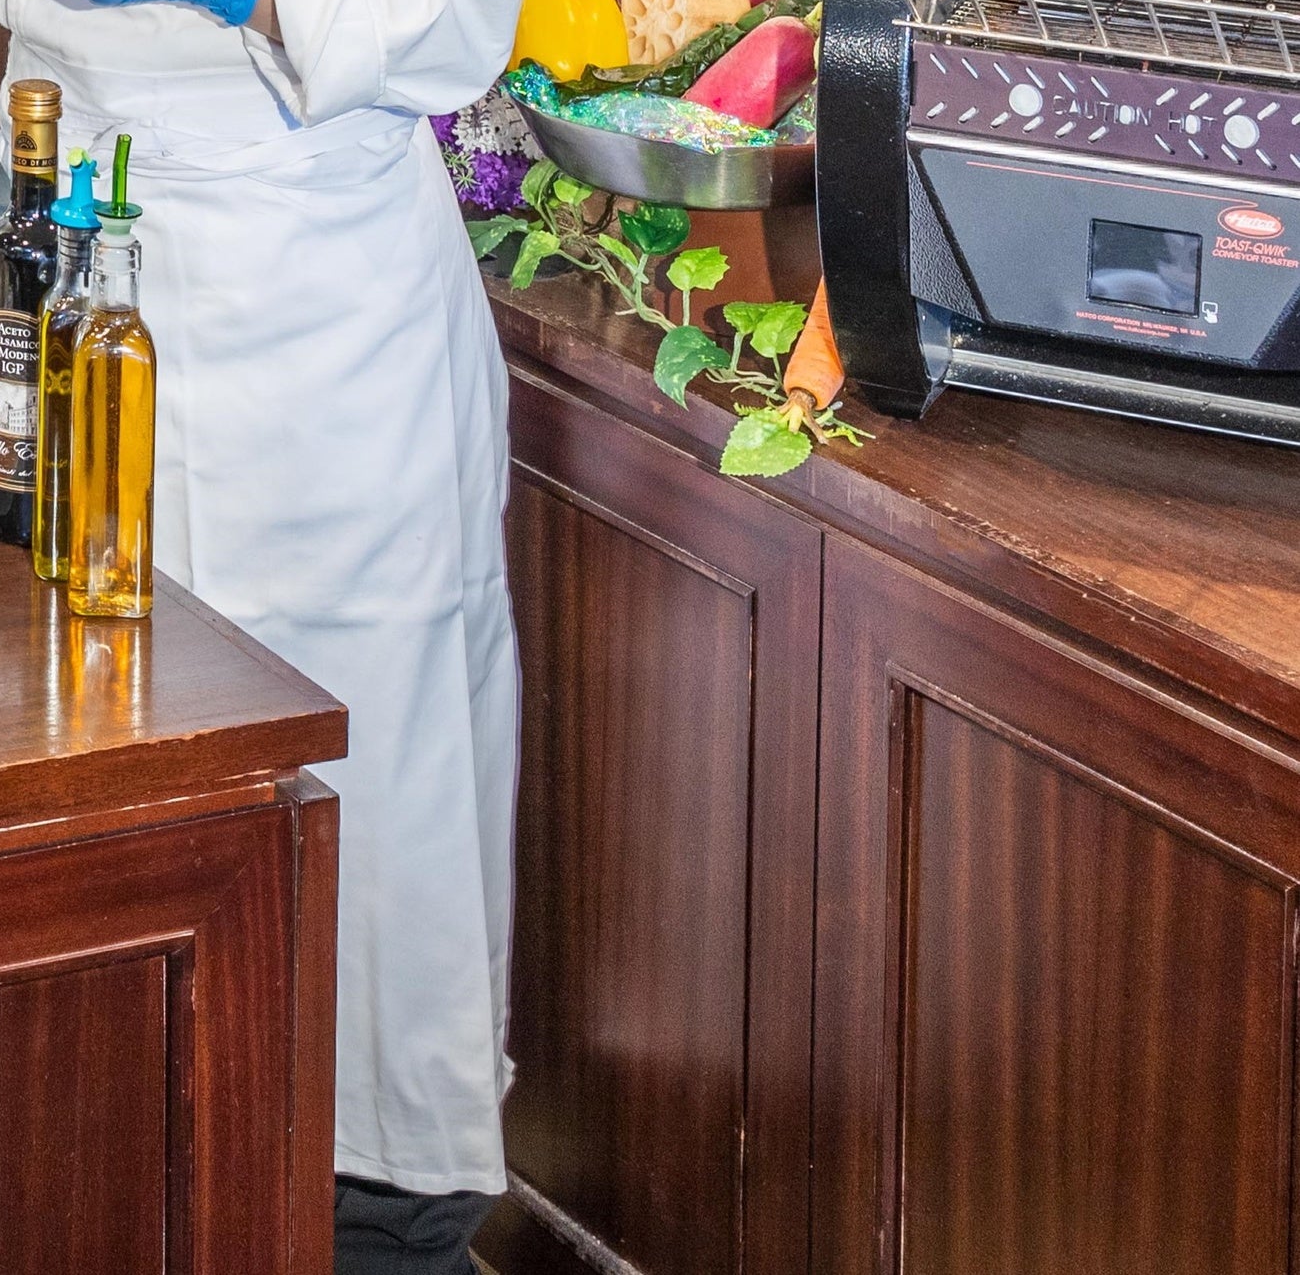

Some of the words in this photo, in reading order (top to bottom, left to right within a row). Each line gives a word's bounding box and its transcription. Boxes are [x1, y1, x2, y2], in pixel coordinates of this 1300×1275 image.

[1053, 94, 1152, 126] CAUTION
[1168, 111, 1217, 135] HOT
[1212, 248, 1259, 262] CONVEYOR
[1260, 255, 1299, 268] TOASTER
[1097, 314, 1140, 327] CORPORATION
[1, 360, 25, 375] IGP
